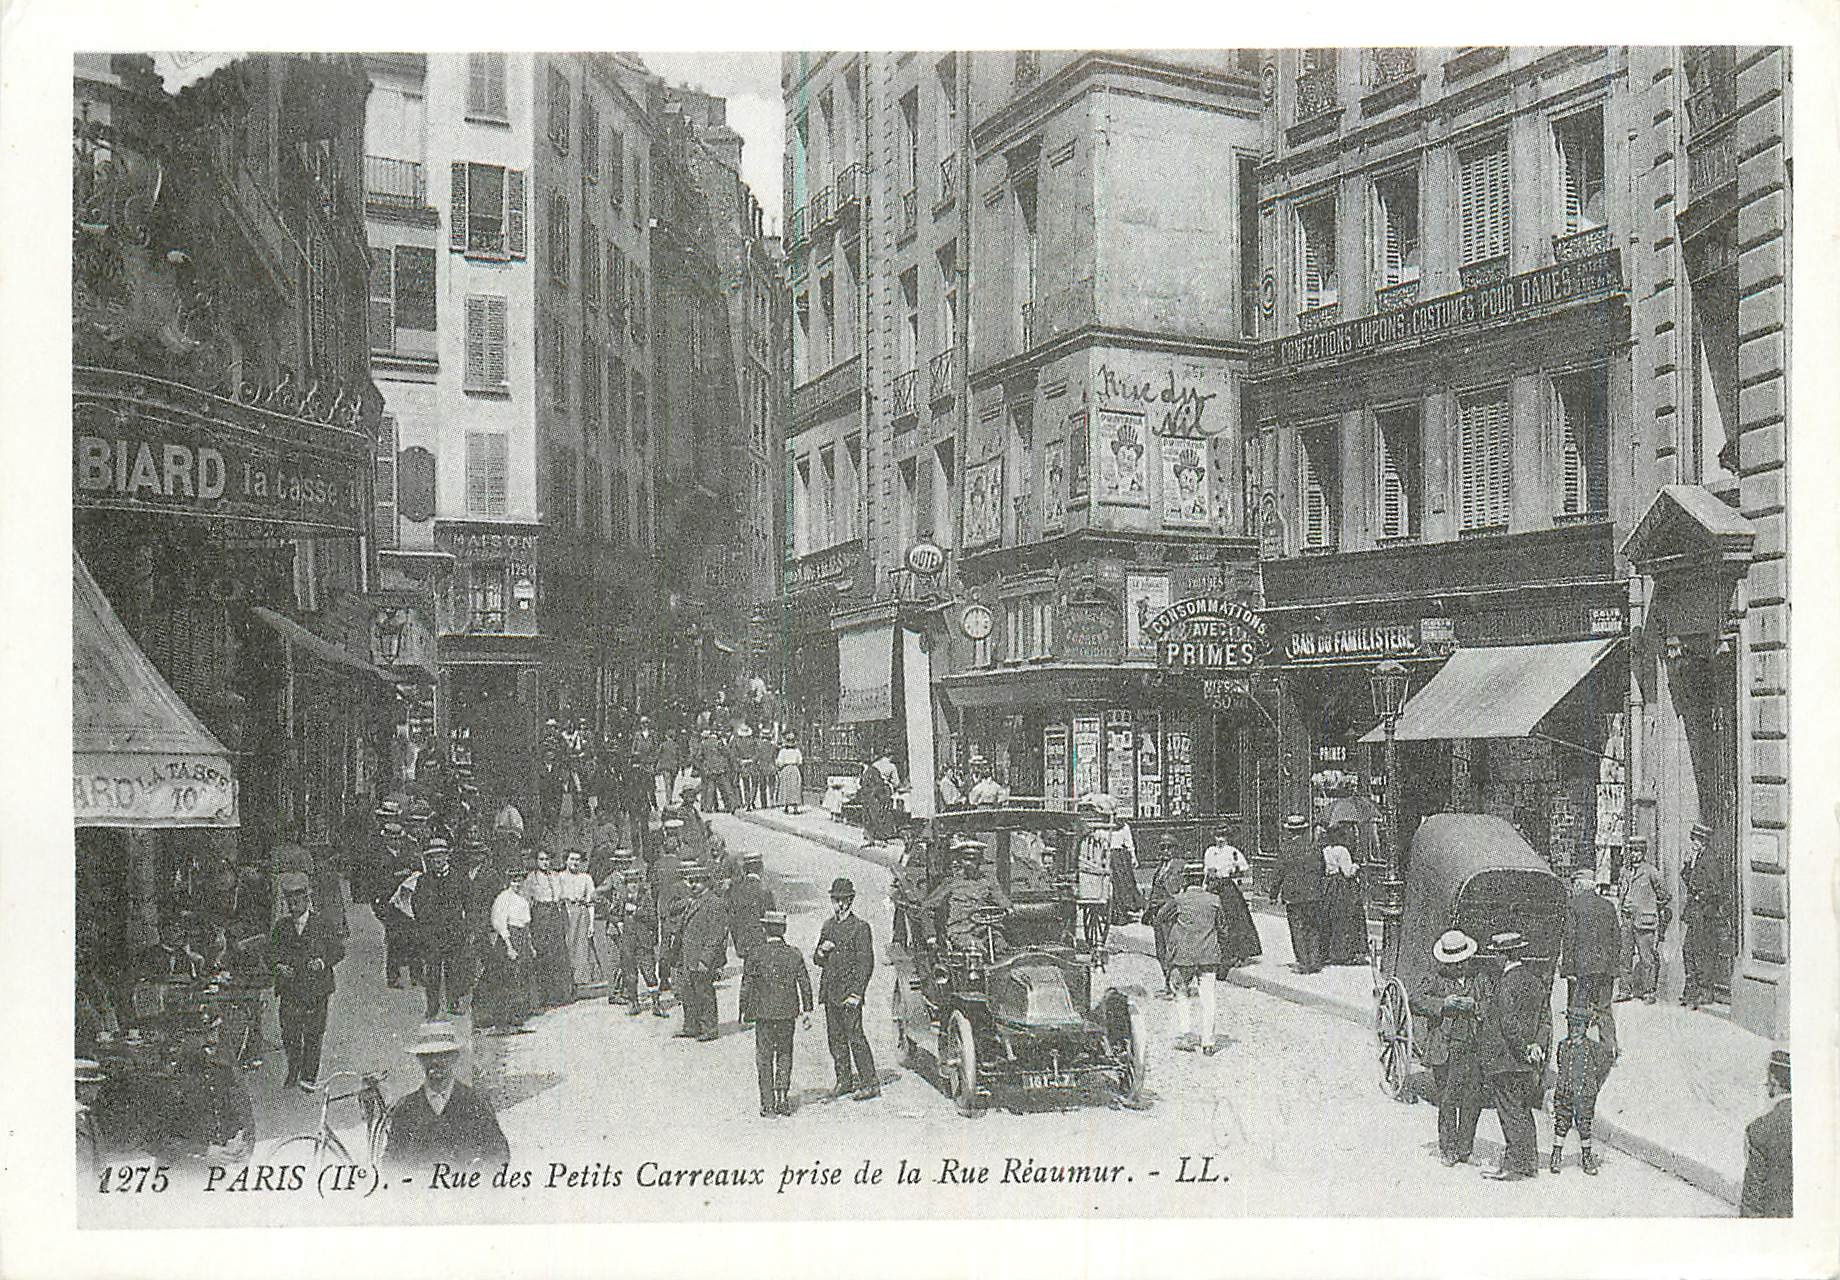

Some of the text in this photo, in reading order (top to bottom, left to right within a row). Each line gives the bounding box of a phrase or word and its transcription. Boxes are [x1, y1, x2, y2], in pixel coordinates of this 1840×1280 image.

[1280, 325, 1353, 364] CONFECTIONS
[1412, 294, 1476, 335] COSTUMES
[1480, 283, 1516, 318] POUR
[1520, 266, 1572, 308] DAMES
[78, 435, 227, 500] BIARD
[242, 462, 269, 498] la
[276, 469, 340, 507] tasse
[1152, 598, 1267, 636] CONSOMMATIONS
[1166, 642, 1255, 667] PRIMES
